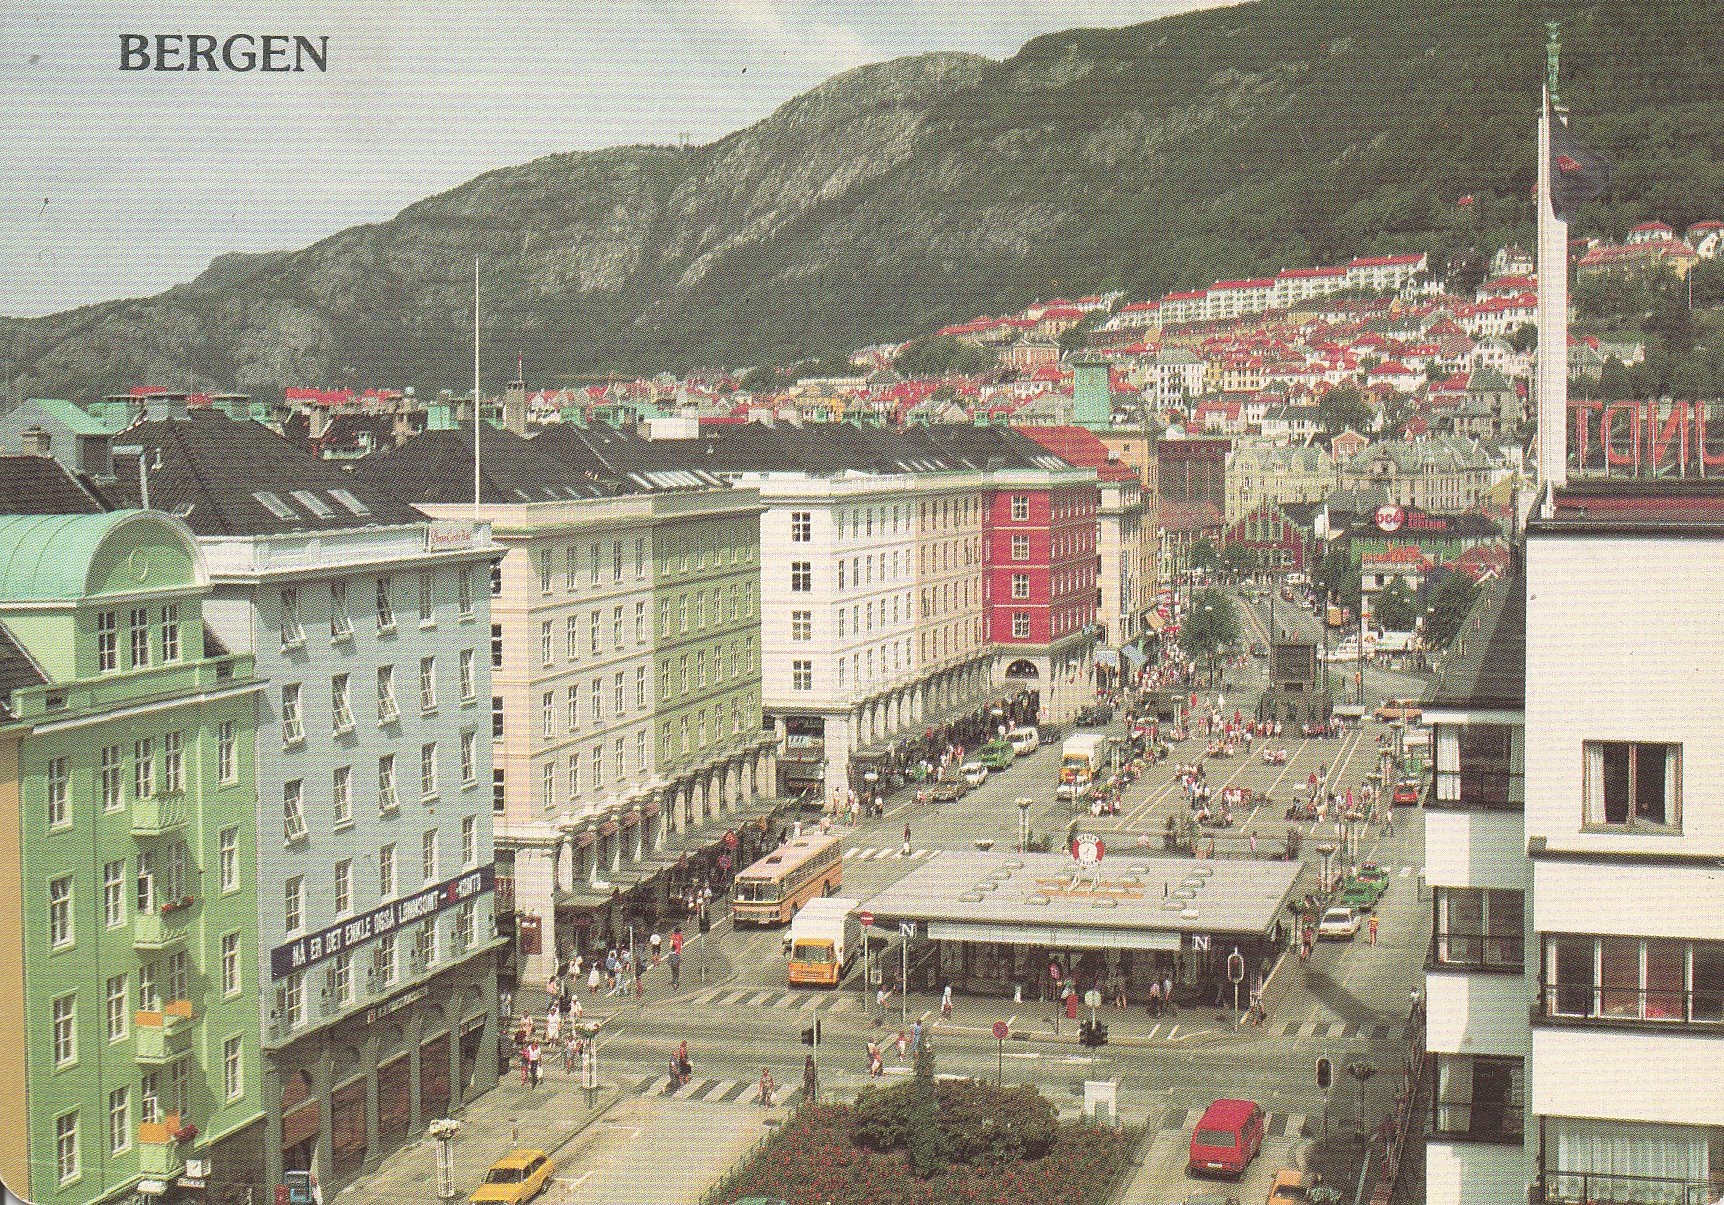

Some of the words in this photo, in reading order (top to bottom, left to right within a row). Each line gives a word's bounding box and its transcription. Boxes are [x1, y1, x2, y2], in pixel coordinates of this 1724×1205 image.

[900, 922, 915, 937] N
[310, 937, 322, 960] ER
[325, 928, 342, 954] DET
[1192, 935, 1209, 951] N
